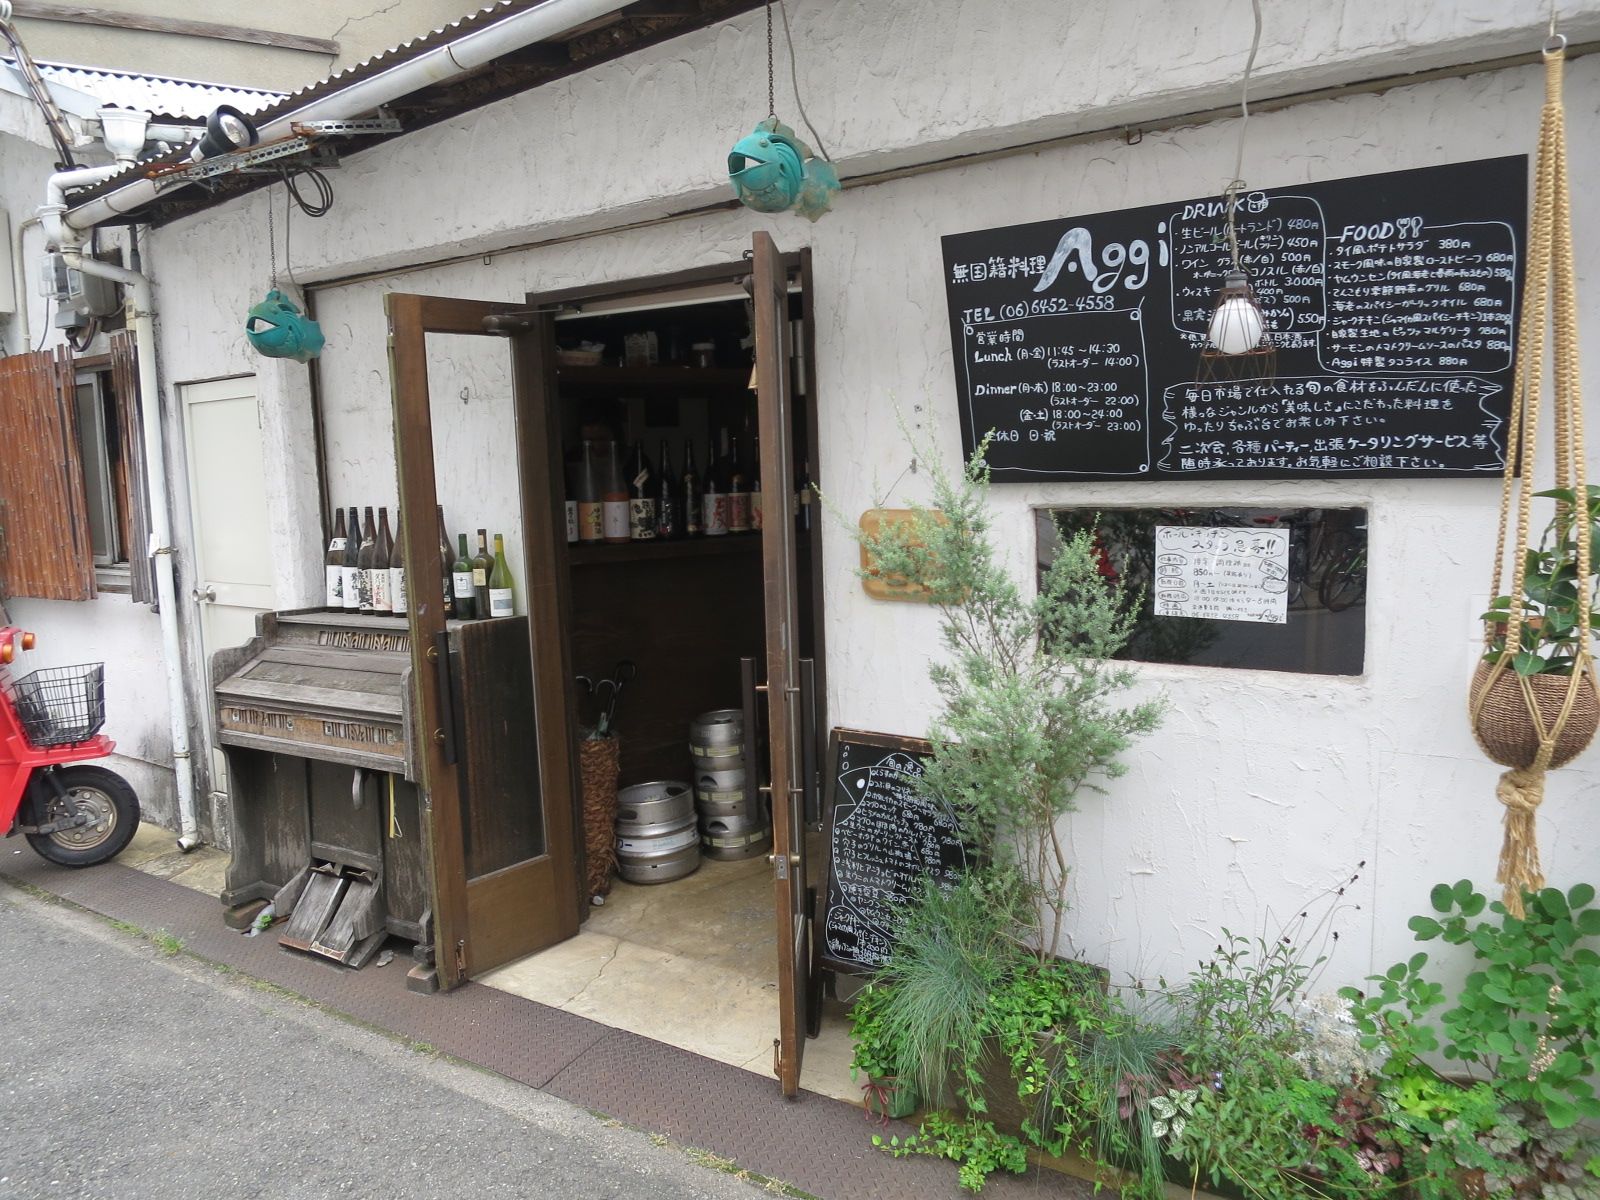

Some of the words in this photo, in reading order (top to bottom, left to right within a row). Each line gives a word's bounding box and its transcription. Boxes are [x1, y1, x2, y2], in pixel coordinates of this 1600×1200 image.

[1287, 219, 1319, 230] 480円
[1340, 222, 1394, 243] FOOD
[1287, 238, 1318, 249] 450円
[1336, 240, 1429, 255] タイ風ポテトサラダ
[1439, 239, 1471, 249] 380円
[1032, 222, 1169, 294] Aggi
[1182, 258, 1209, 270] ワイン
[1281, 252, 1312, 262] 500円
[1486, 253, 1514, 262] 680円
[952, 255, 1047, 284] 無国籍料理
[1458, 282, 1487, 292] 680円
[1474, 297, 1502, 307] 680円
[963, 307, 995, 323] TEL
[976, 329, 1024, 345] 営業時間
[974, 347, 1013, 363] Lunch
[1331, 358, 1358, 368] Aggi
[1439, 357, 1468, 366] 880円
[974, 383, 1017, 396] Dinner
[1185, 379, 1477, 402] 毎日市場で仕入れる旬の食材をふんだんに使った
